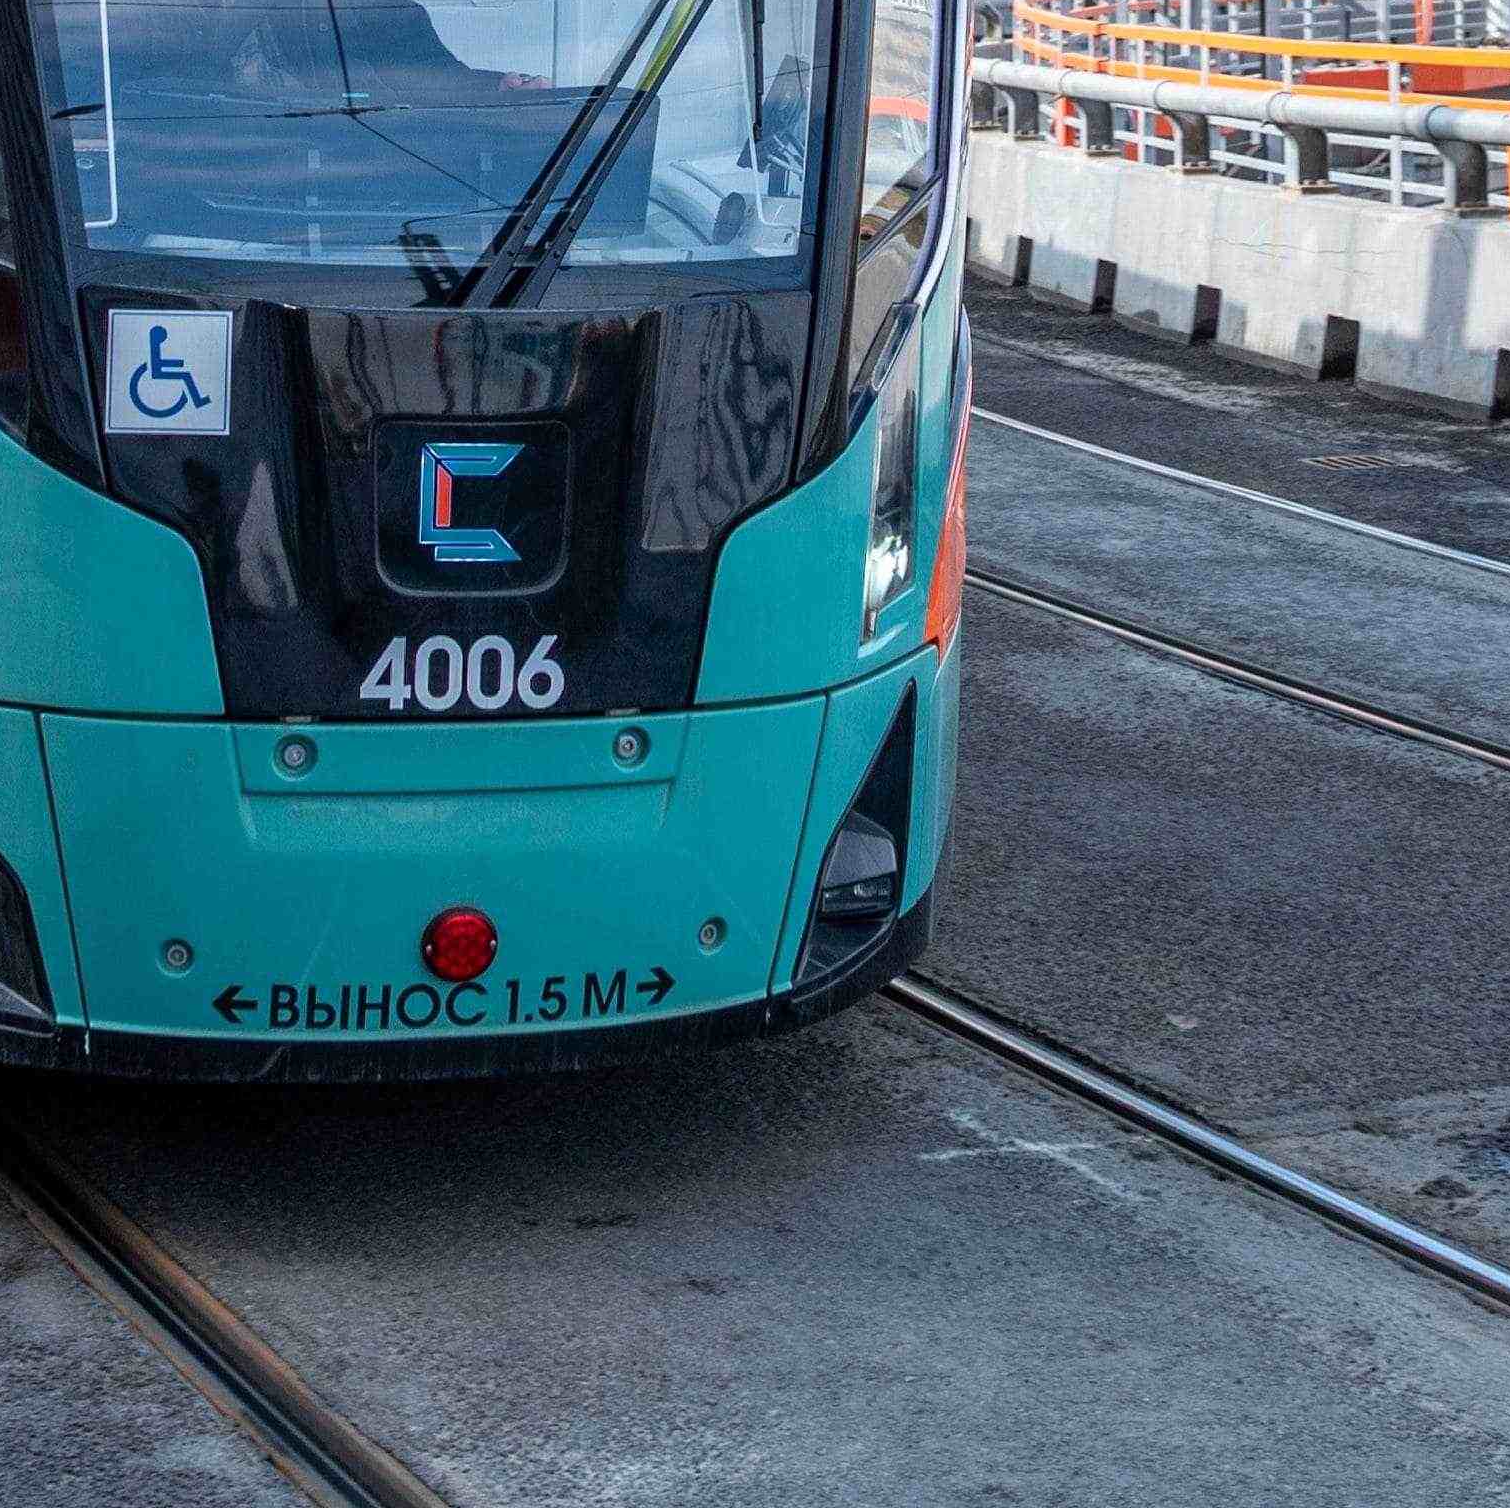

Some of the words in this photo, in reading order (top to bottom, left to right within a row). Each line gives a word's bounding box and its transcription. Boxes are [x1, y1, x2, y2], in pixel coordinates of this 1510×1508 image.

[359, 635, 565, 711] 4006
[269, 982, 488, 1030] ВЫНОС
[506, 976, 568, 1023] 1.5
[582, 969, 627, 1017] М
